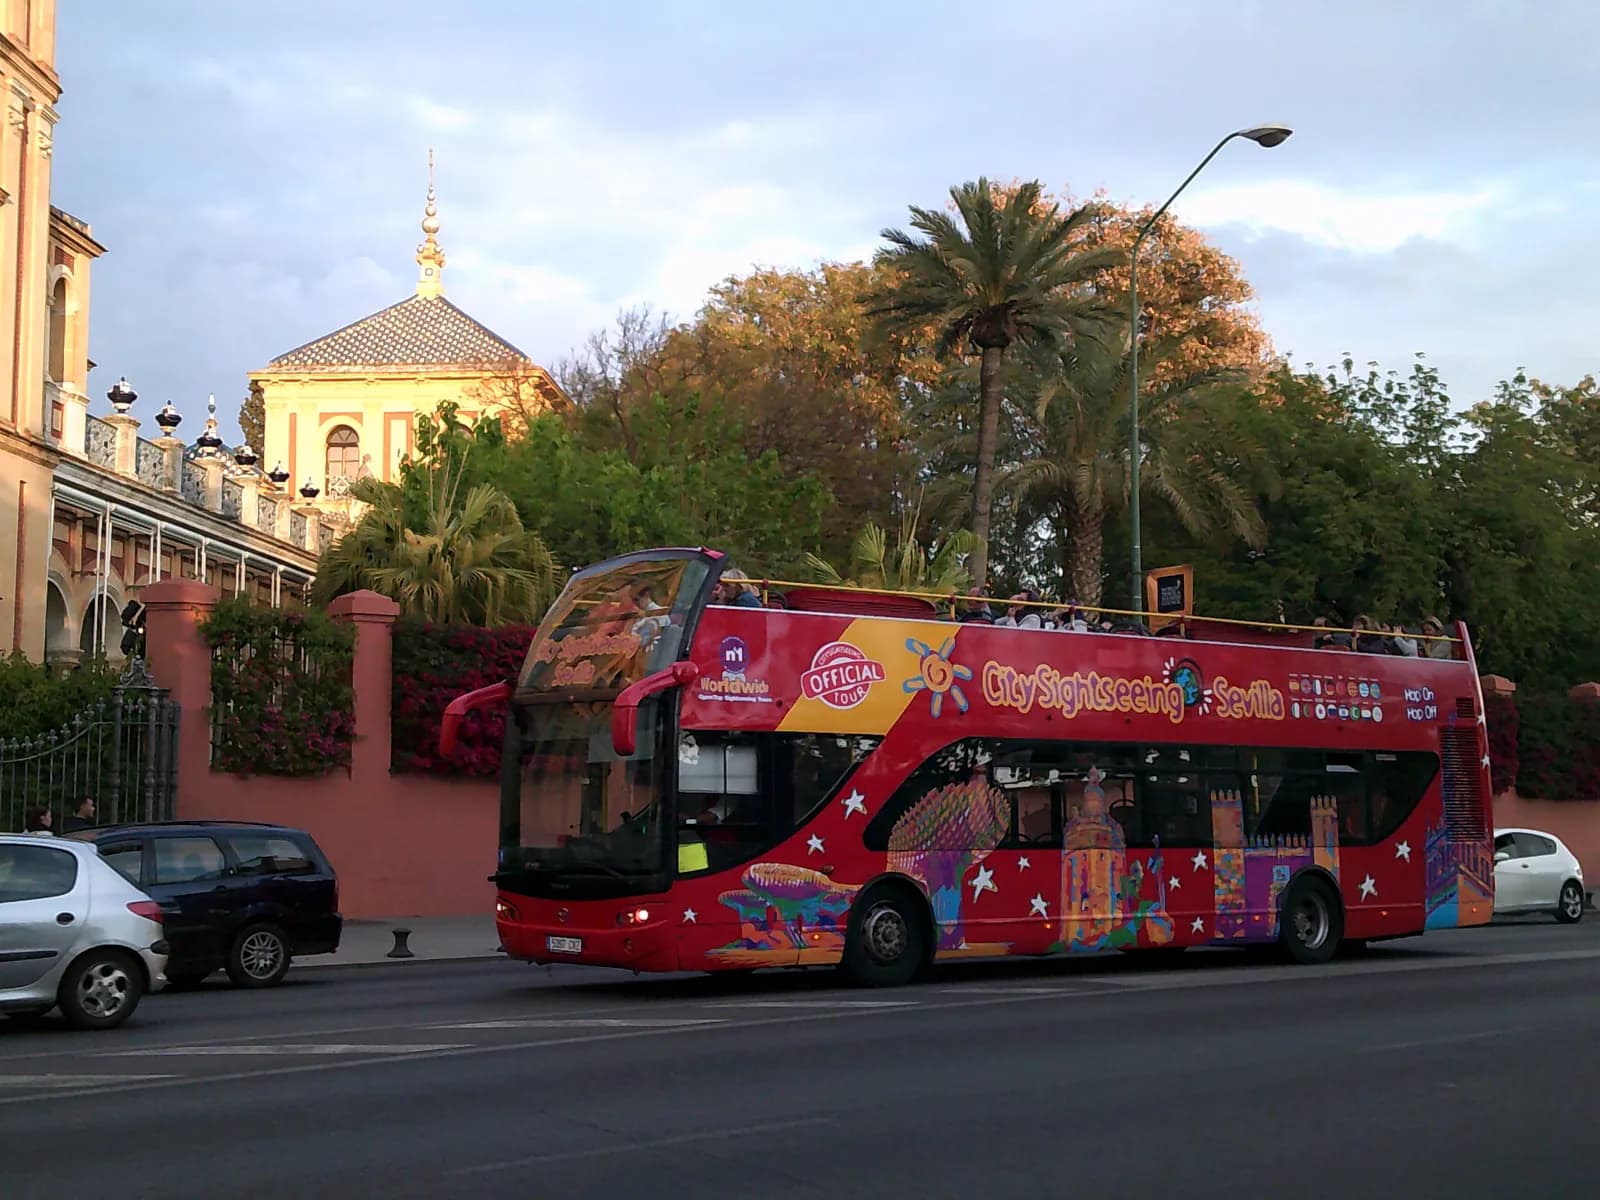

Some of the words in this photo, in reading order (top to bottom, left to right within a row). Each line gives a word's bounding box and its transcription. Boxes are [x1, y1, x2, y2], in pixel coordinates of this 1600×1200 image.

[810, 664, 882, 693] OFFICIAL
[834, 686, 867, 705] TOUR
[983, 660, 1184, 724] CitySightseeing
[1213, 676, 1285, 720] Sevilla
[1404, 688, 1421, 703] Hop
[1422, 686, 1434, 701] On
[1407, 706, 1423, 721] Hop
[1424, 704, 1437, 720] Off
